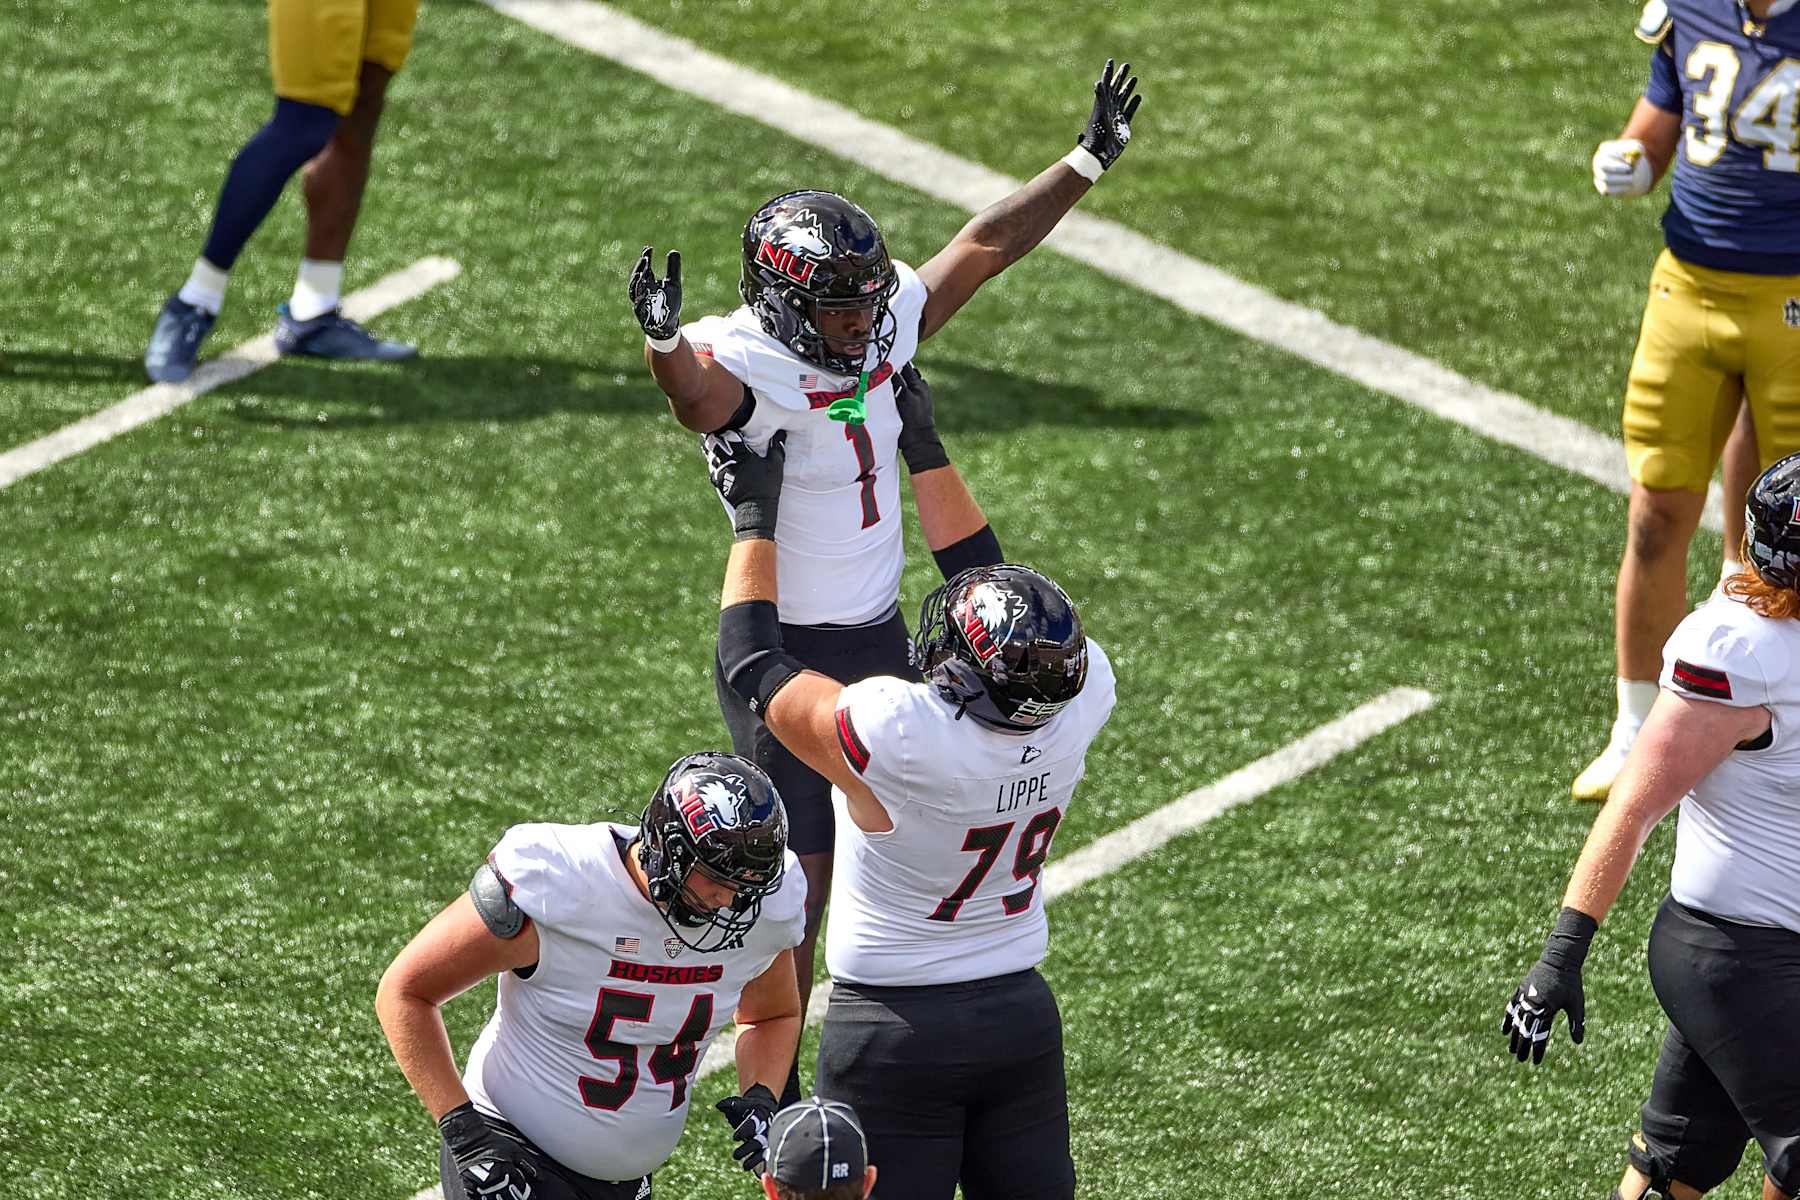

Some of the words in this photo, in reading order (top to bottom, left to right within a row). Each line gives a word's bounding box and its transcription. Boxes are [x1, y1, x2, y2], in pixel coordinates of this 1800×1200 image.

[758, 240, 815, 283] NIU
[844, 421, 881, 530] 1
[955, 599, 997, 658] NIU
[996, 772, 1051, 813] LIPPE
[926, 806, 1062, 923] 79
[607, 960, 724, 985] HUSKIES
[577, 987, 714, 1112] 54
[832, 1163, 849, 1178] RR
